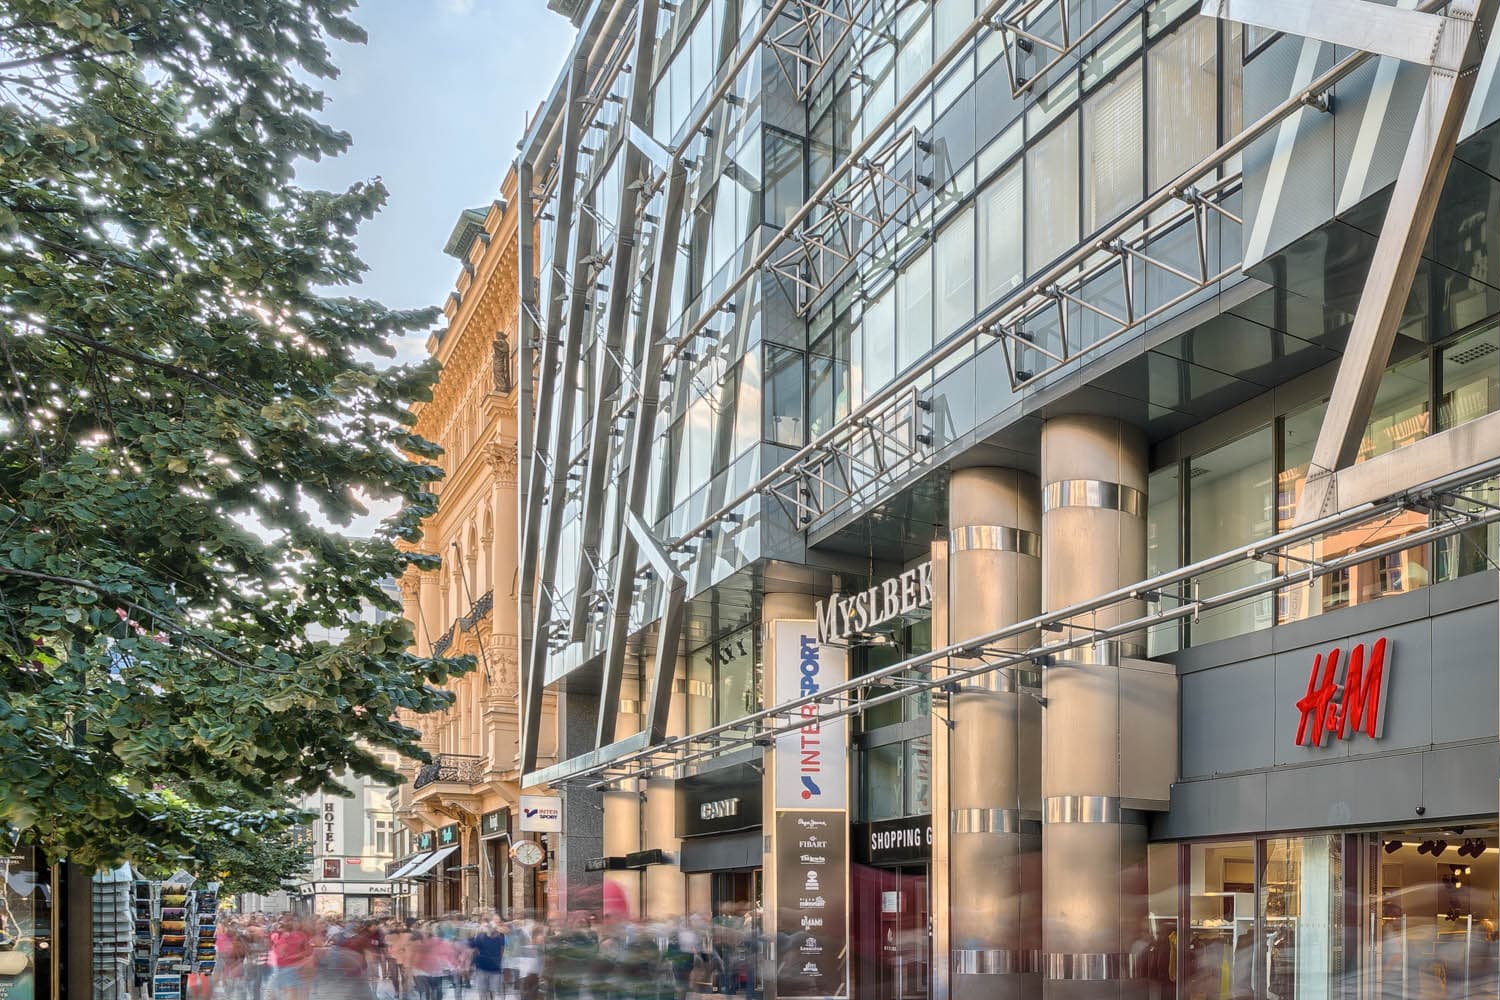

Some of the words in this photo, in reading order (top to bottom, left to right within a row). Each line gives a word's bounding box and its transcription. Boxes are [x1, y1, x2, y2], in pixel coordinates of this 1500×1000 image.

[1296, 637, 1393, 747] H&M
[700, 798, 738, 820] GANT
[324, 803, 334, 853] HOTEL
[871, 828, 921, 850] SHOPPING
